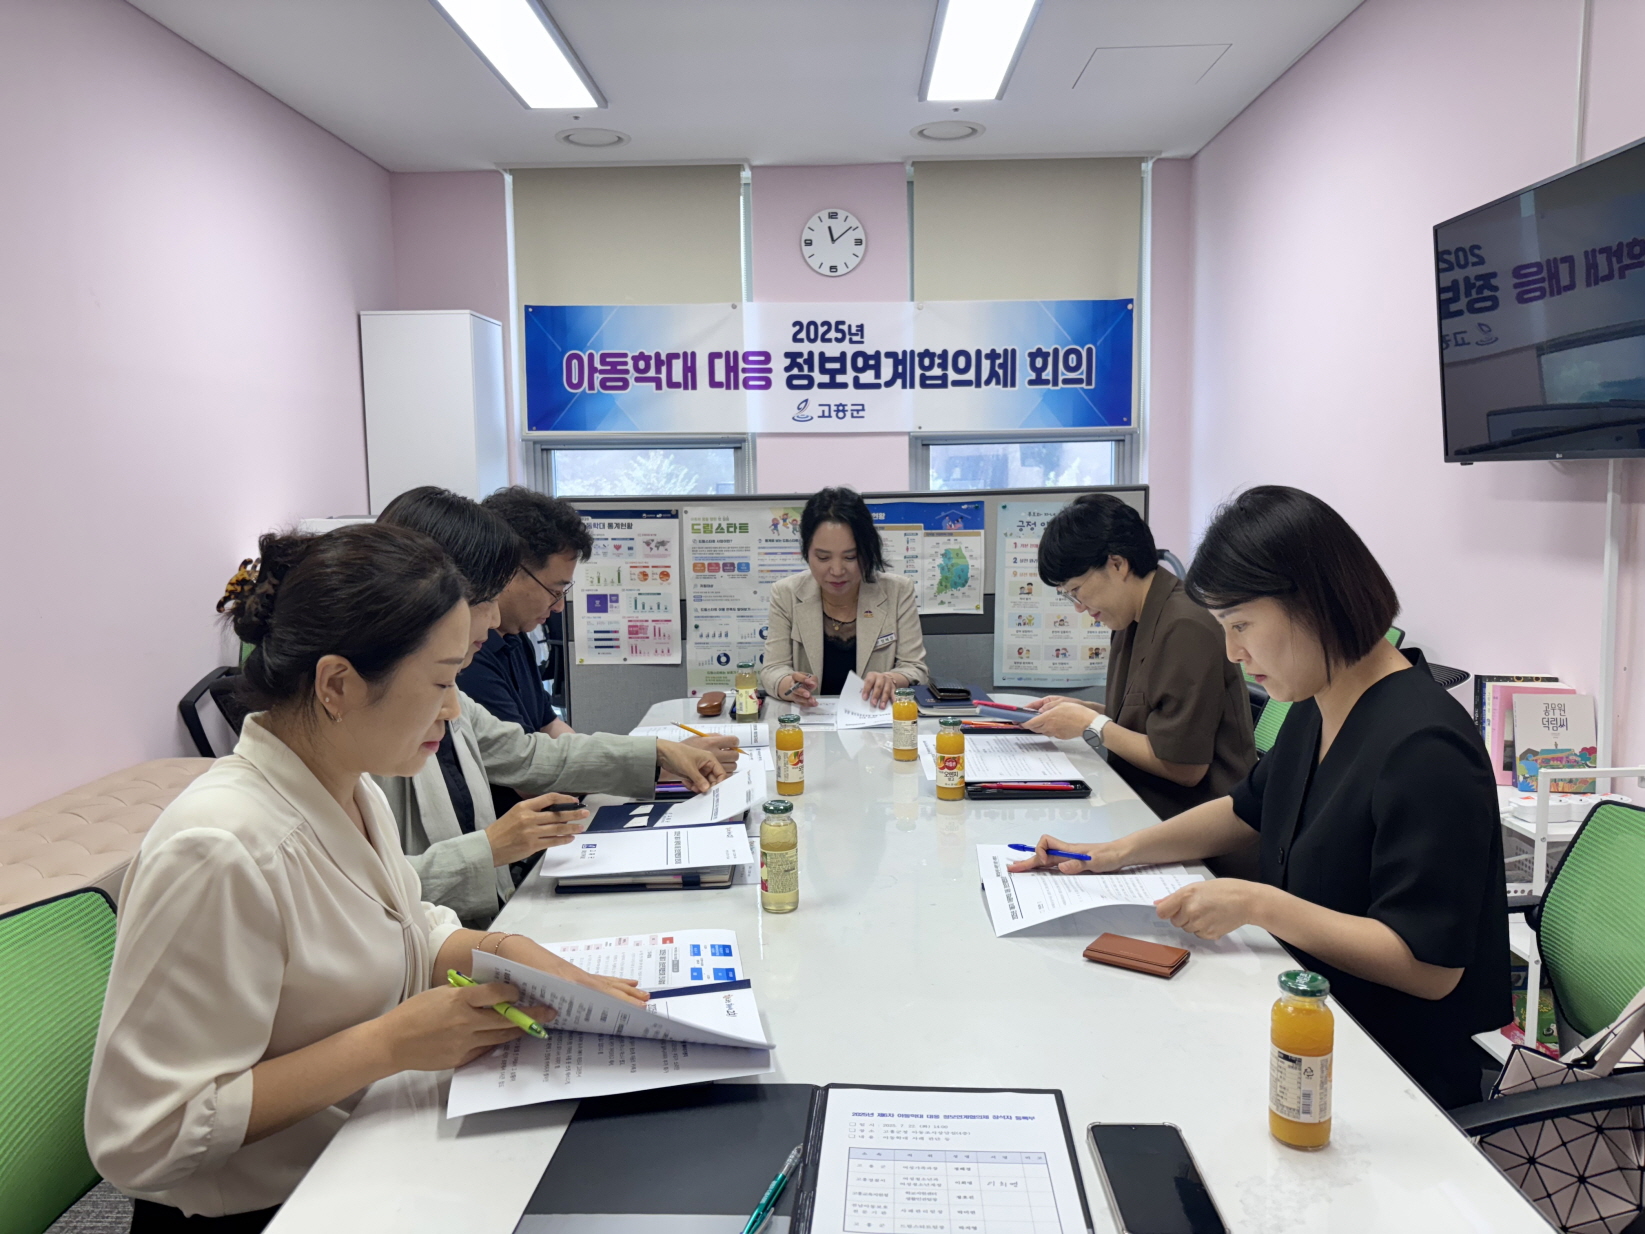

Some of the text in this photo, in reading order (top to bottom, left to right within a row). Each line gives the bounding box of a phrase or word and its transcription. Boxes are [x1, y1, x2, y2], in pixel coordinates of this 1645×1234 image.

[828, 212, 838, 220] 12
[792, 320, 865, 344] 2025년
[564, 346, 1095, 392] 아동학대 대응 정보연계협의체 회의
[816, 402, 866, 420] 고흥군
[607, 522, 633, 530] 통계현황
[691, 522, 749, 534] 드림스타트
[1017, 520, 1036, 531] 긍정
[1542, 702, 1566, 717] 공무원
[1542, 717, 1568, 732] 덕림씨
